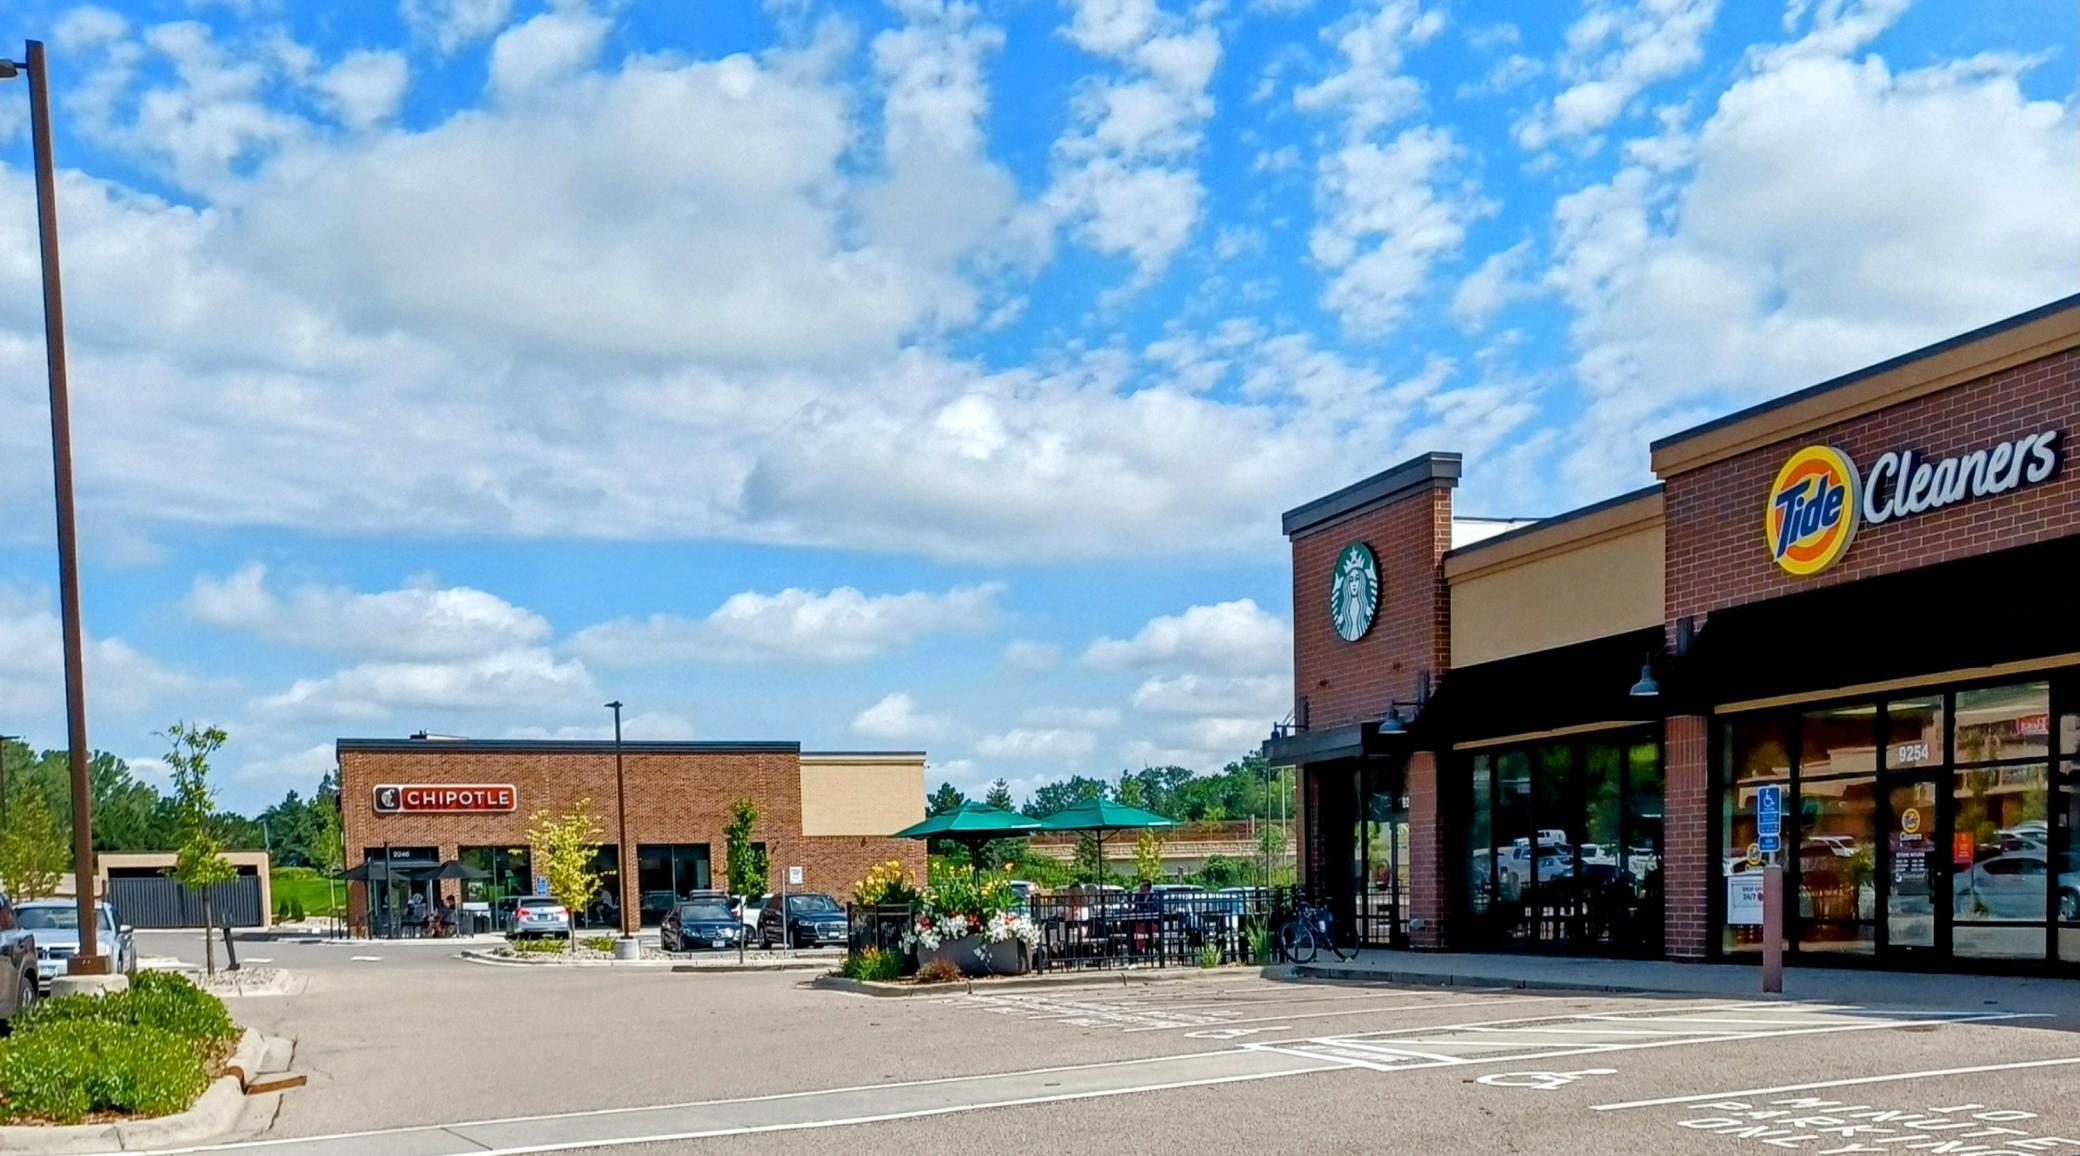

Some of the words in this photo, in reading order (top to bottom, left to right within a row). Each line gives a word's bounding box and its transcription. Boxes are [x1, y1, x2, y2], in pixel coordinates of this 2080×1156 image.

[1773, 469, 1846, 563] Tide
[1863, 430, 2057, 524] Cleaners
[1899, 743, 1929, 762] 9254
[407, 790, 510, 805] CHIPOTLE
[1743, 892, 1756, 901] 24/7
[1676, 1117, 1889, 1155] ONLY
[1769, 1097, 2080, 1150] MINUTE
